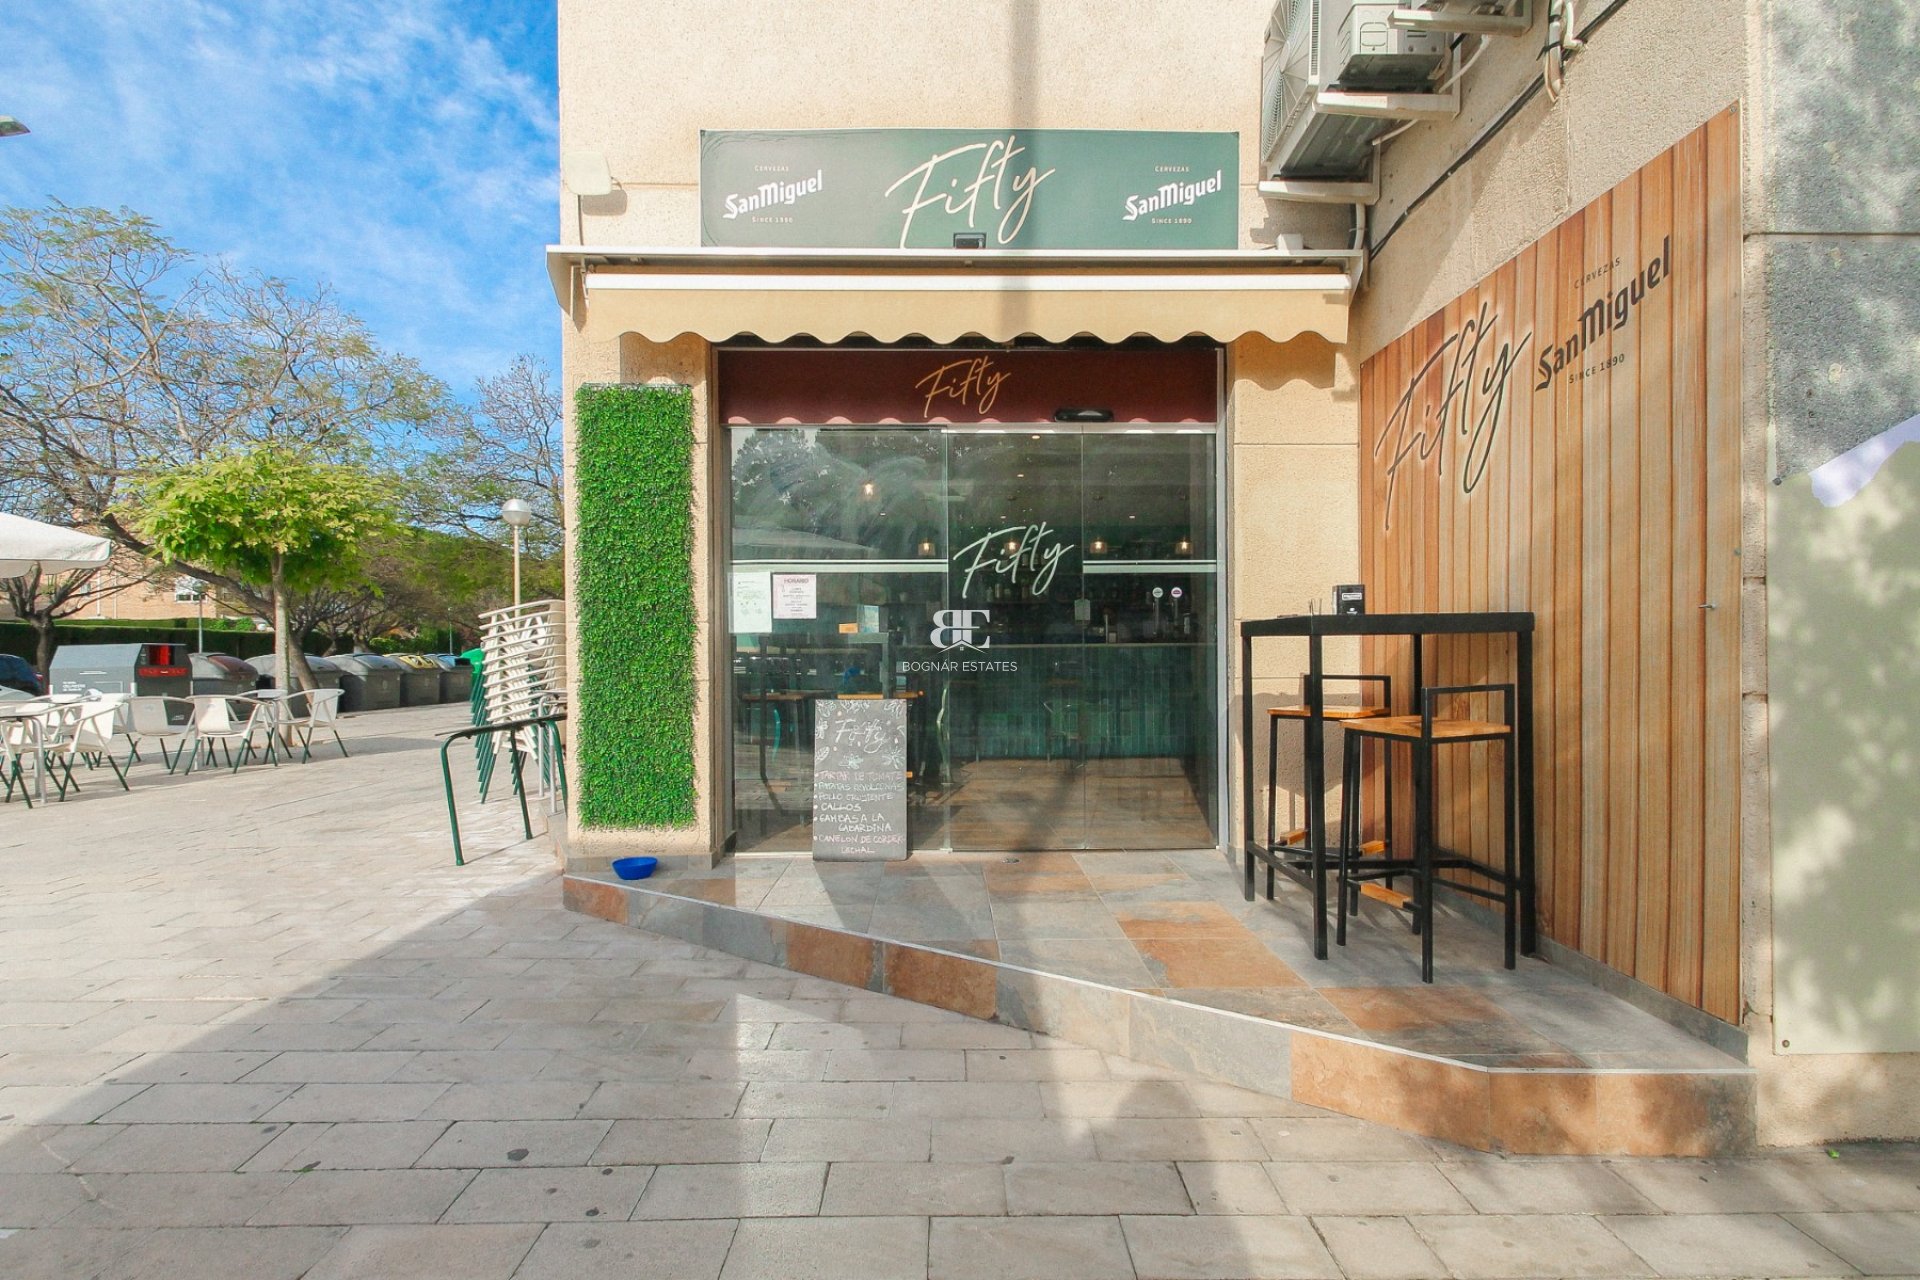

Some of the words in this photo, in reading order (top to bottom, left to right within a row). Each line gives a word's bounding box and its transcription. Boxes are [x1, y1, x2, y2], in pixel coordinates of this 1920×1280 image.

[884, 135, 1056, 249] Fifty
[1574, 256, 1621, 289] CERVEZAS
[1569, 366, 1597, 384] SINCE
[1600, 353, 1625, 372] 1890
[915, 355, 1013, 419] Fifty
[1374, 301, 1532, 531] Fifty
[953, 521, 1075, 599] Fifty
[819, 813, 859, 824] GAMBAS
[860, 813, 868, 823] A
[871, 812, 886, 823] LA
[821, 802, 862, 812] CALLOS
[860, 835, 872, 844] DE
